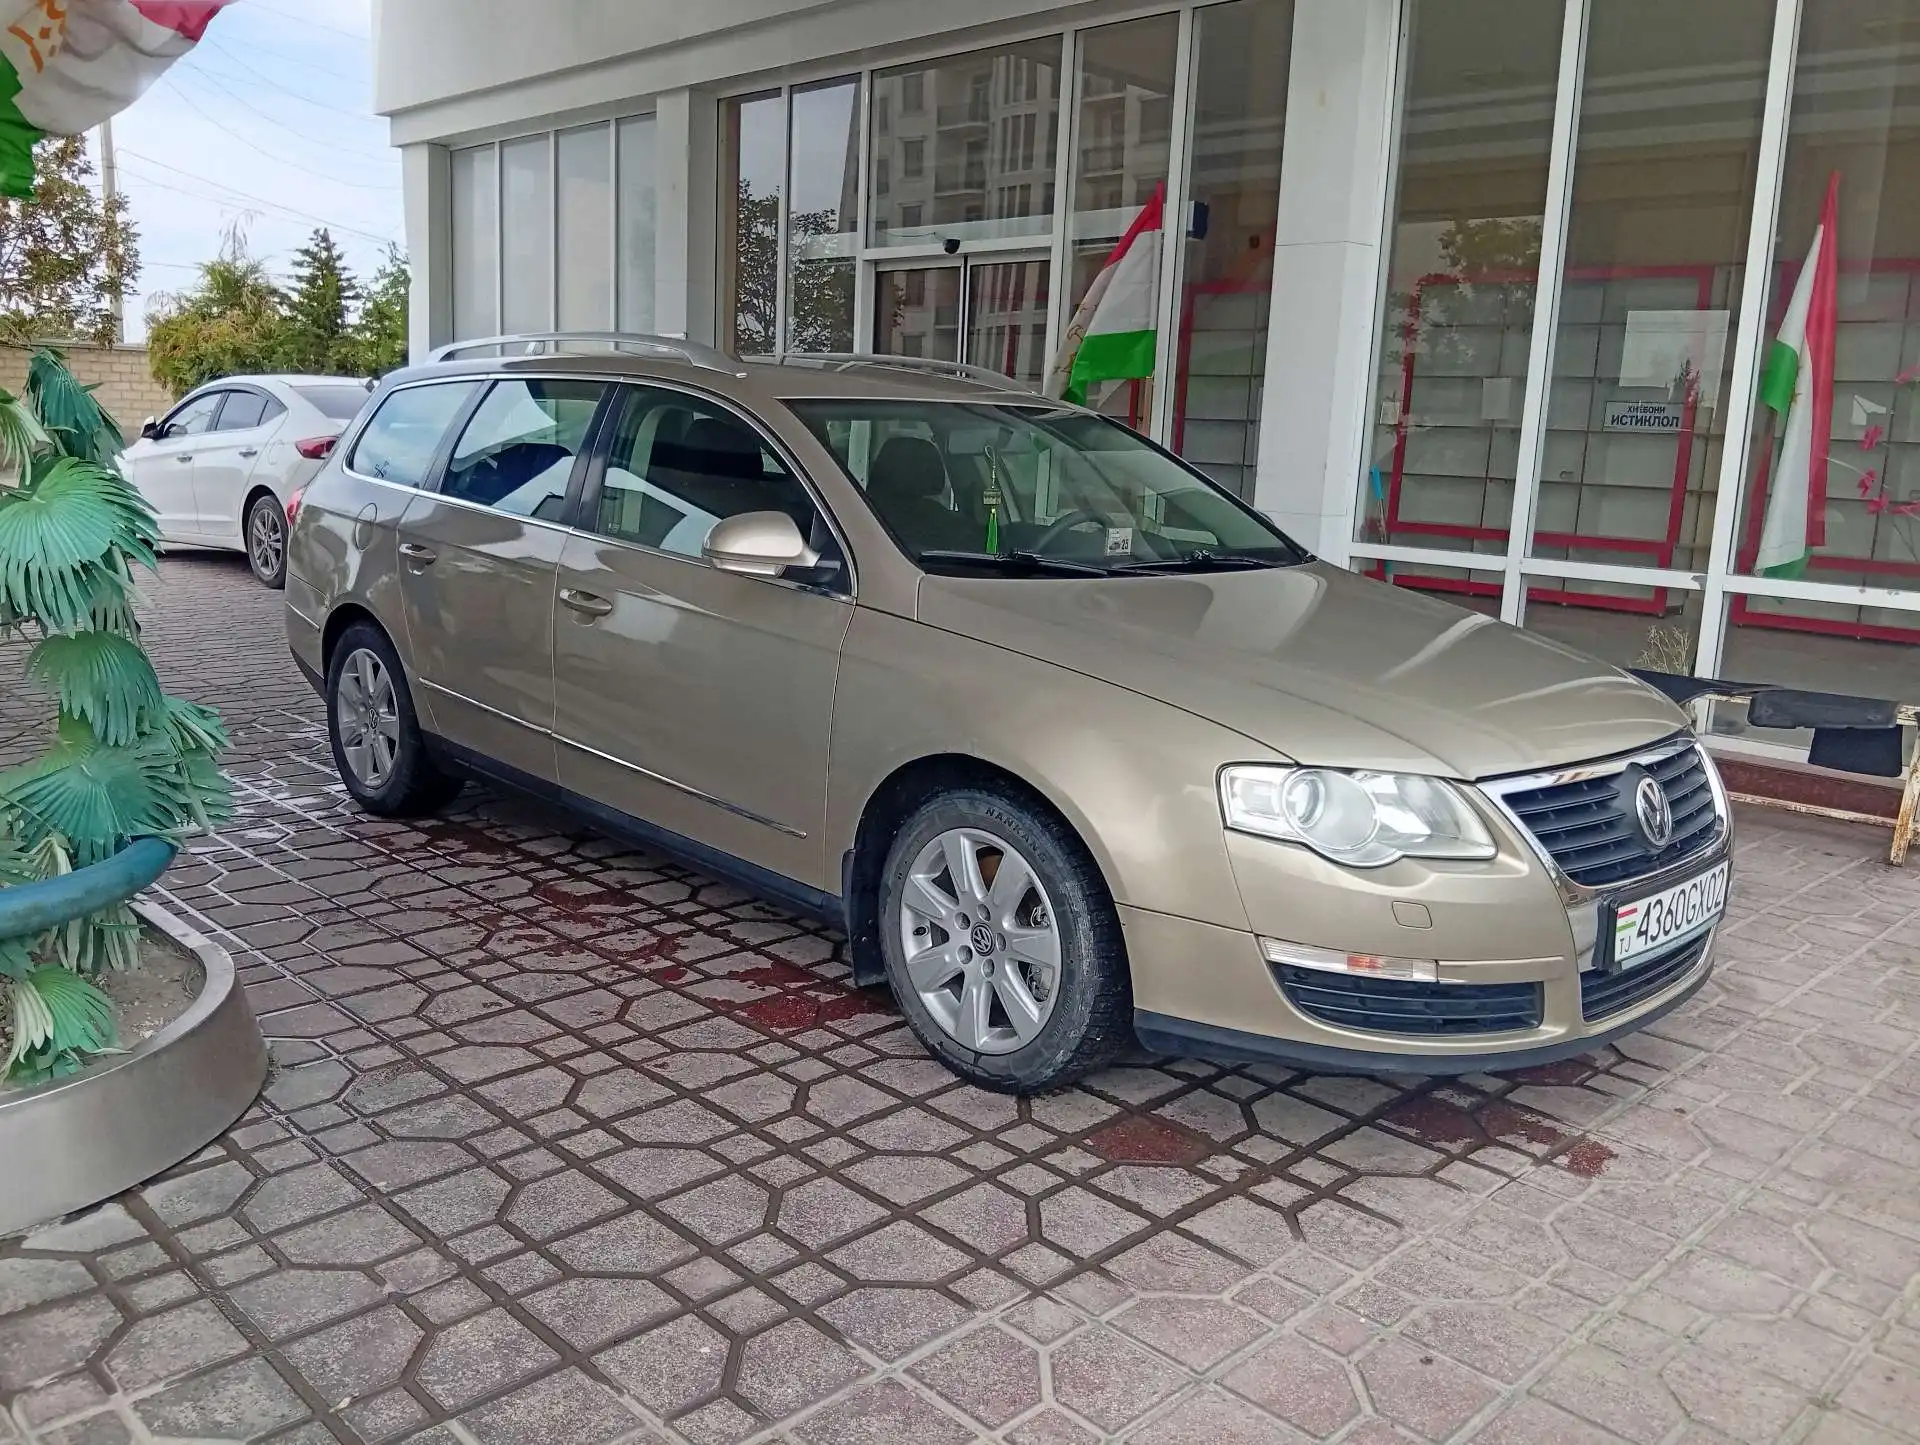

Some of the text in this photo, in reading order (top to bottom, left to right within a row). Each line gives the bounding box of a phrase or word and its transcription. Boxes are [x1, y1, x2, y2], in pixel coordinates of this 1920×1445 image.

[1611, 414, 1680, 428] ИСТИКЛОЛ
[1121, 538, 1129, 550] 25
[1636, 867, 1725, 946] 4360GX02
[1619, 935, 1631, 955] TJ
